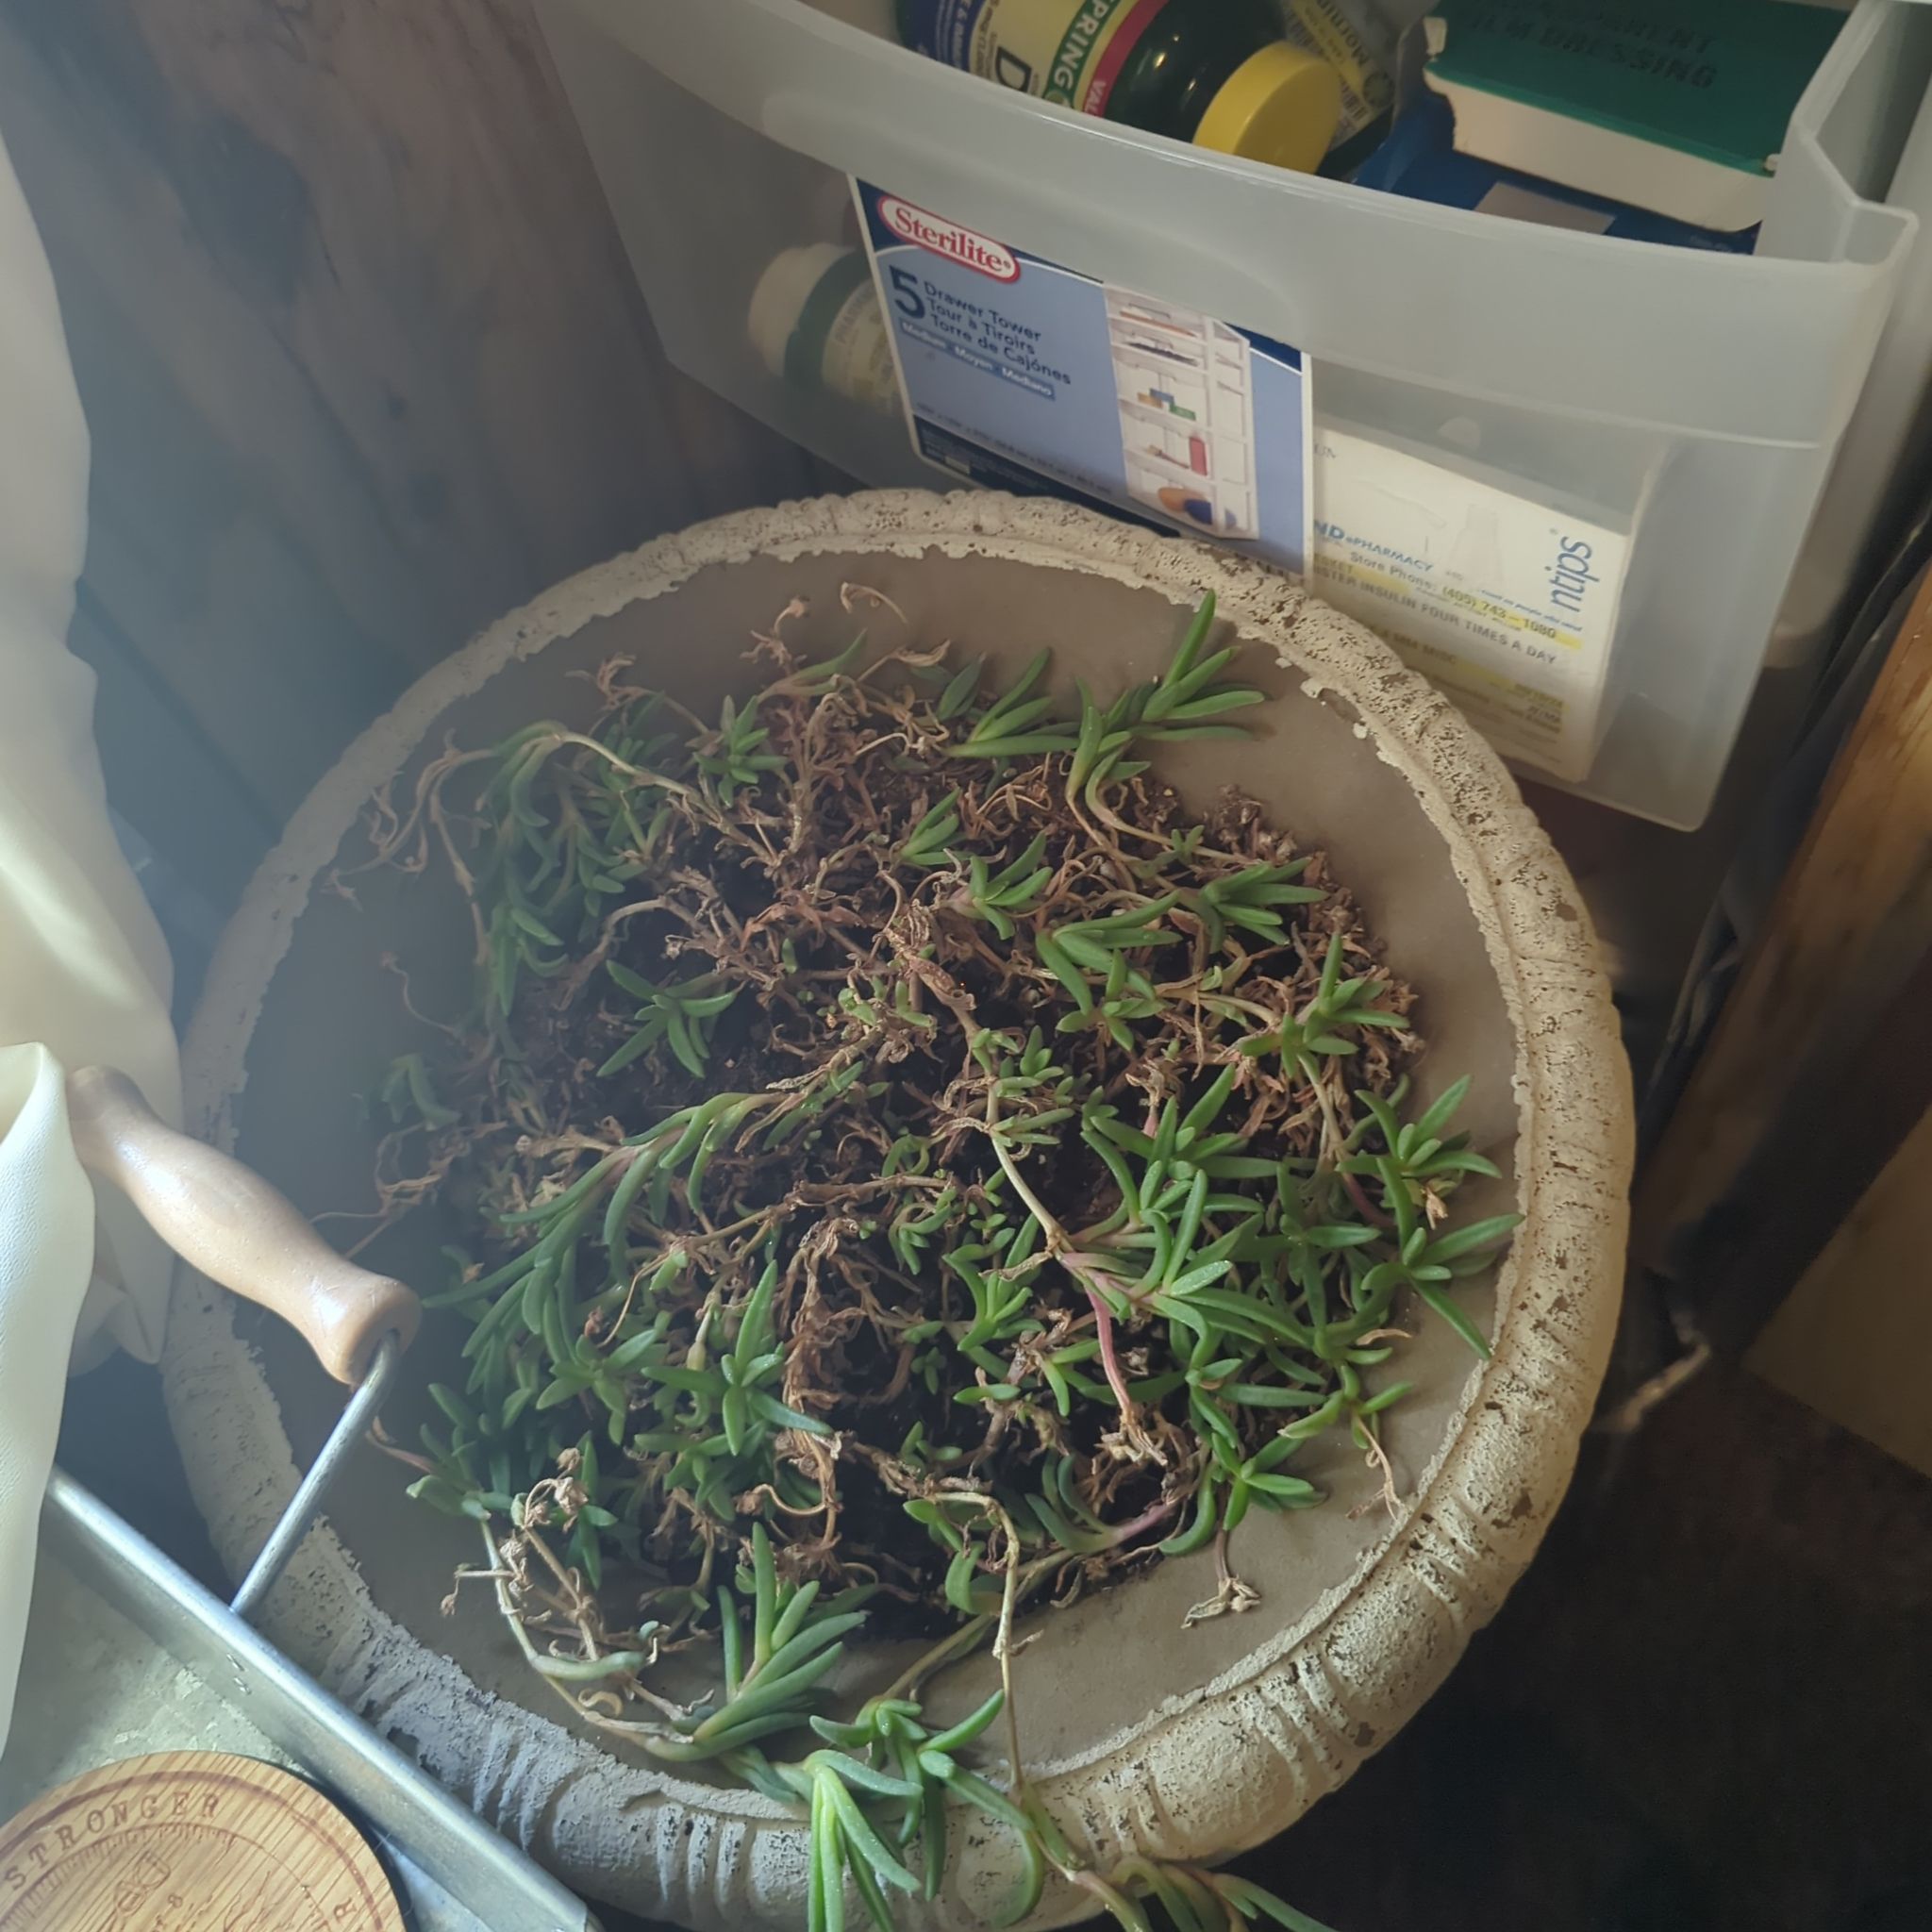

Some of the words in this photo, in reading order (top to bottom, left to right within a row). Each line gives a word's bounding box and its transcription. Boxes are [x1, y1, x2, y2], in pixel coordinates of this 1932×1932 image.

[1053, 0, 1114, 91] PRING
[895, 206, 1004, 273] Sterilite
[889, 264, 925, 319] 5
[924, 281, 984, 318] Drawer
[988, 308, 1041, 341] Tower
[927, 298, 964, 323] Tour
[982, 322, 1036, 356] Tiroirs
[930, 313, 973, 342] Torre
[977, 336, 1000, 355] de
[1350, 551, 1386, 571] Store
[1421, 604, 1460, 626] FOUR
[1465, 621, 1508, 646] TIMES
[1511, 640, 1523, 652] A
[1526, 645, 1557, 665] DAY
[3, 1790, 221, 1892] STRONGER
